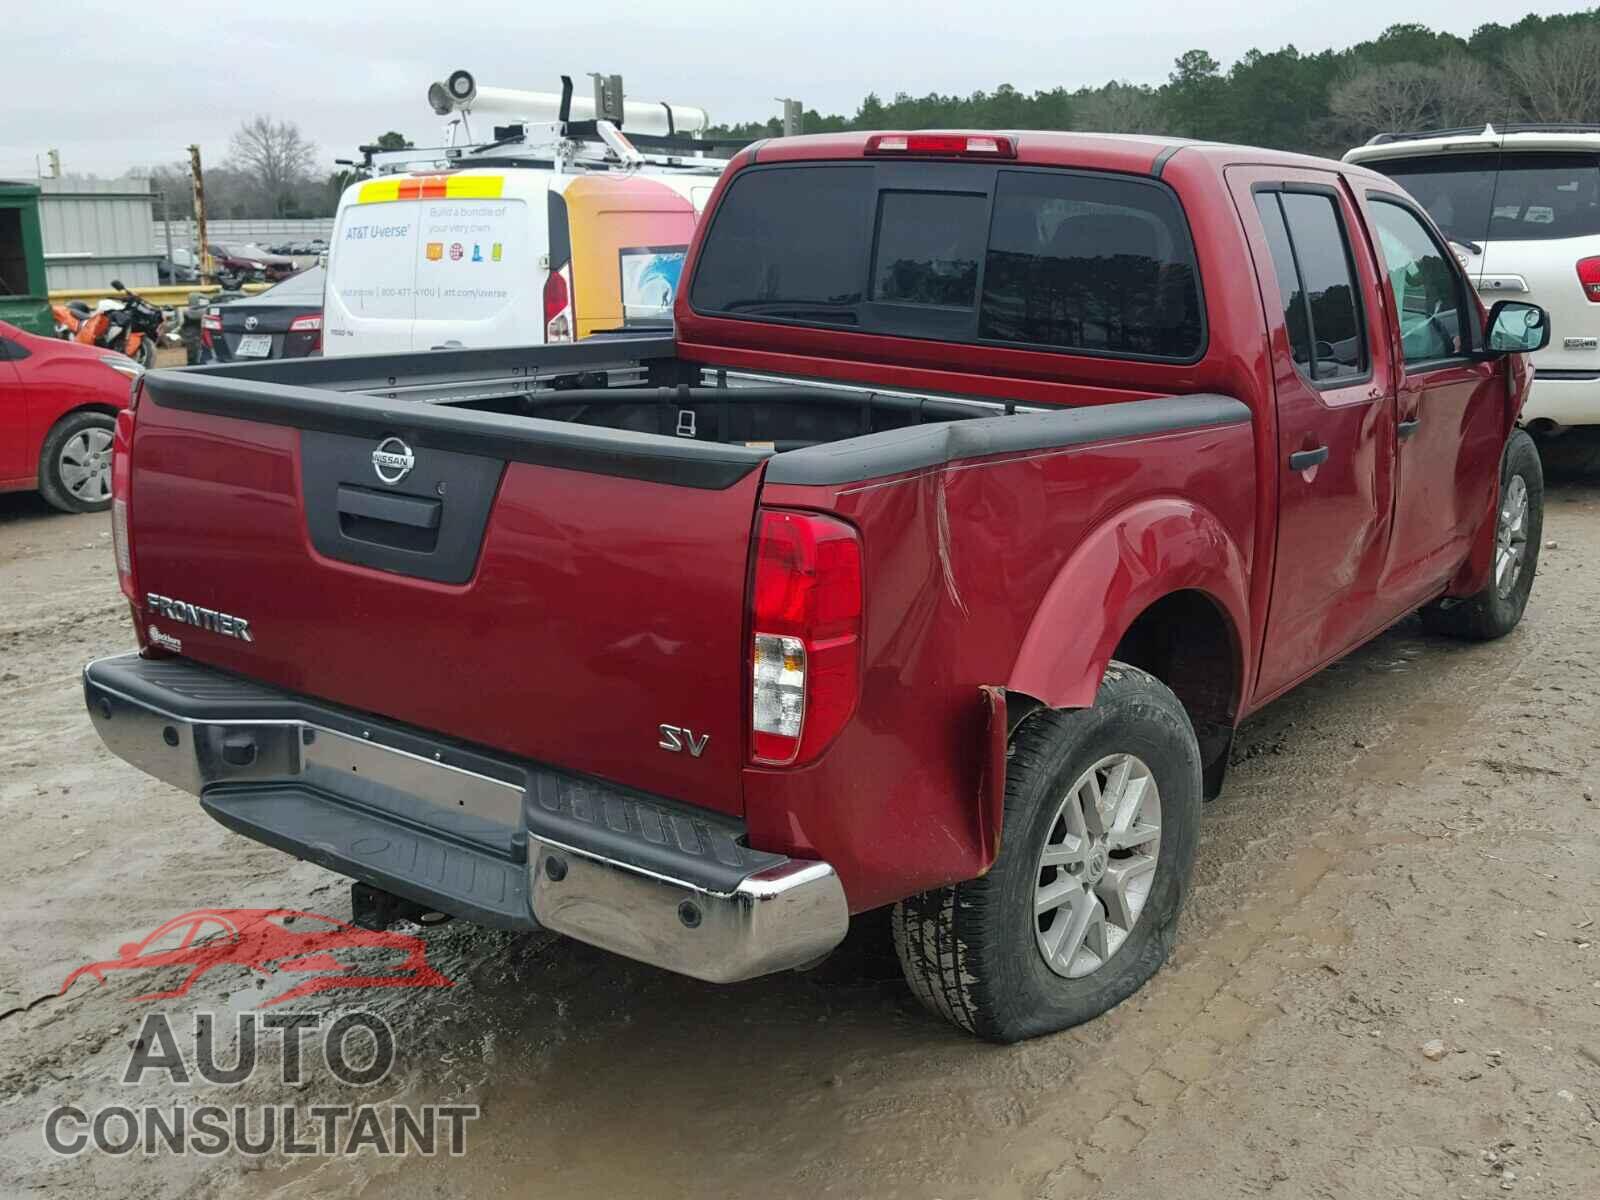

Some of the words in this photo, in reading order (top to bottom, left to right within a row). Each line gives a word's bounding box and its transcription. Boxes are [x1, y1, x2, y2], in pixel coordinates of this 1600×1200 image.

[345, 225, 369, 240] AT&T
[374, 454, 409, 466] NISSAN
[147, 592, 253, 642] FRONTIER
[659, 723, 710, 757] SV
